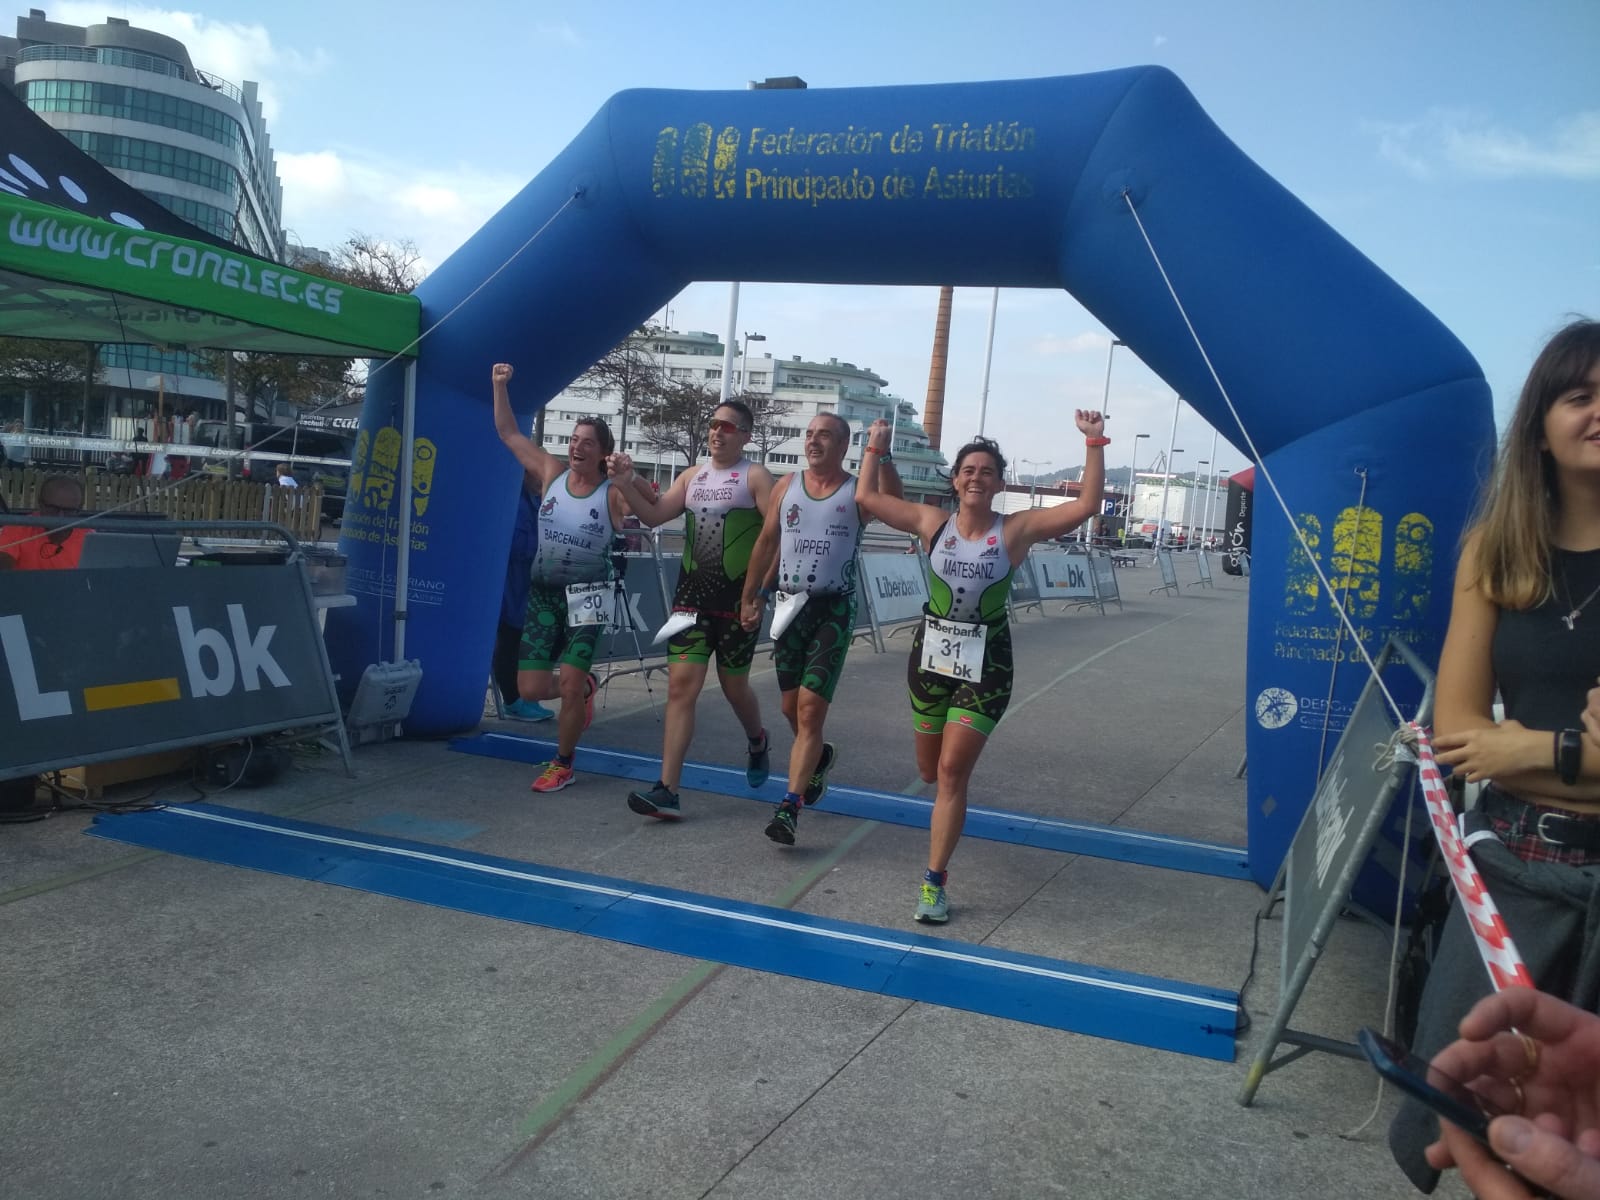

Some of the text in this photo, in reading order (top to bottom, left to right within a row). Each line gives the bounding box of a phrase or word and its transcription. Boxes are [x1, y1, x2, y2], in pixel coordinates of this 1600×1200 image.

[747, 120, 1036, 156] Federación de Triatlón
[745, 164, 1037, 208] Principado de Asturias
[1105, 501, 1114, 512] P
[794, 539, 831, 556] VIPPER
[943, 558, 995, 580] MATESANZ
[875, 576, 922, 599] Liberbank
[583, 594, 603, 610] 30
[928, 618, 982, 639] Liberbank
[940, 638, 963, 660] 31
